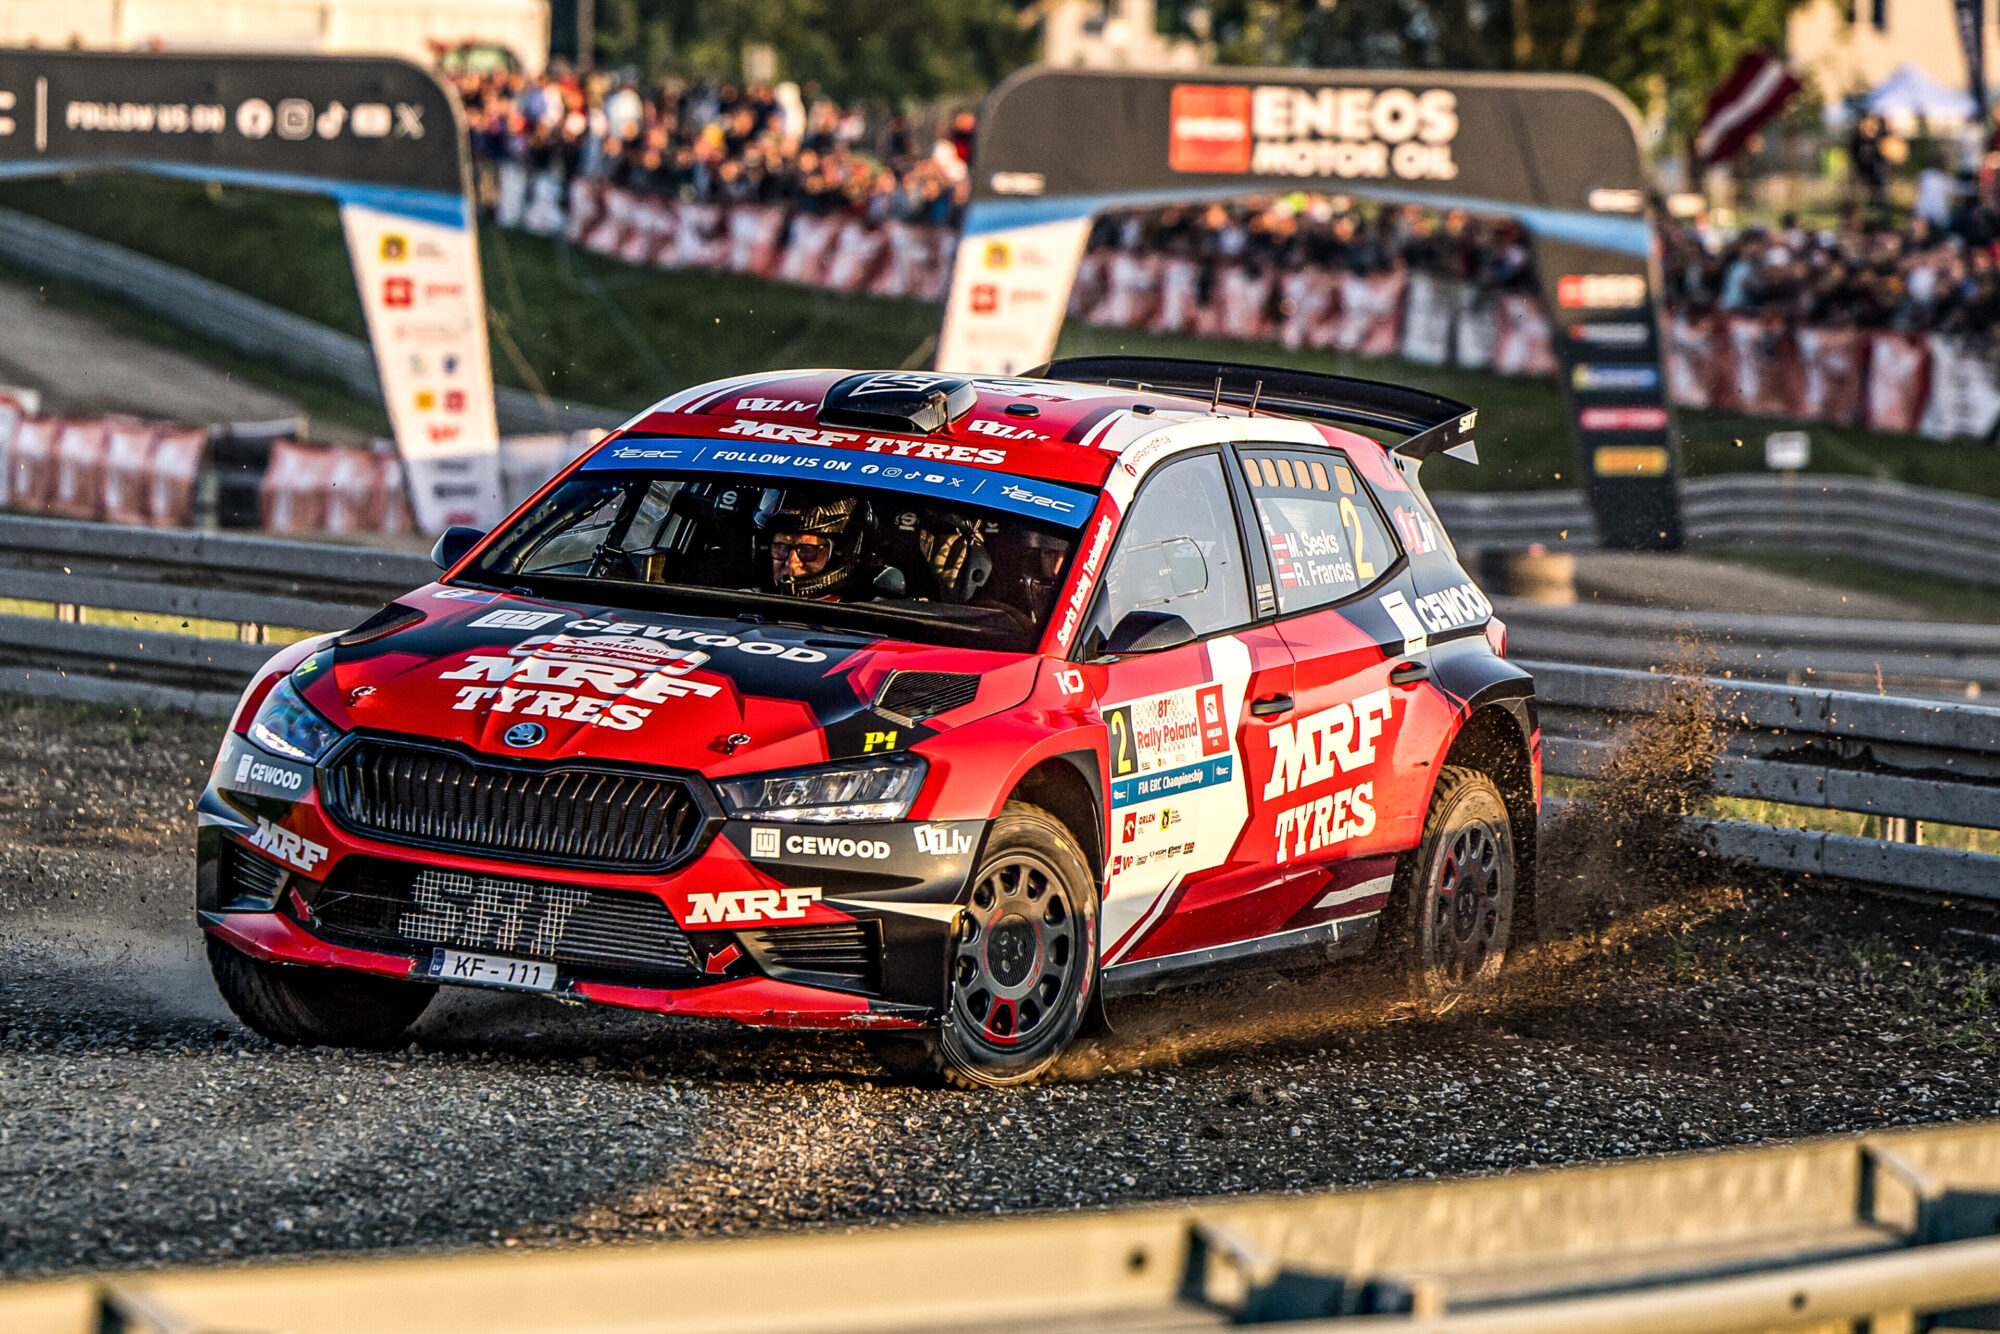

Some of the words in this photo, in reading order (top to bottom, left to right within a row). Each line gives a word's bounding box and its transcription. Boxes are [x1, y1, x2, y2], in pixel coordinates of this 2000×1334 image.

[66, 100, 155, 132] FOLLOW
[157, 103, 190, 134] US
[191, 104, 227, 133] ON
[1252, 86, 1458, 145] ENEOS
[1252, 141, 1389, 177] MOTOR
[1392, 142, 1458, 180] OIL
[713, 450, 791, 465] FOLLOW
[792, 456, 820, 468] US
[823, 459, 852, 471] ON
[718, 419, 860, 447] MRF
[864, 437, 1007, 465] TYRES
[1285, 532, 1303, 558] M.
[1300, 529, 1340, 556] Sesks
[1339, 496, 1377, 579] 2
[1293, 561, 1310, 587] R.
[1307, 557, 1355, 586] Francis
[1070, 572, 1092, 611] Racing
[564, 618, 828, 663] CEWOOD
[591, 641, 644, 651] ORLEN
[646, 647, 670, 656] OIL
[611, 651, 659, 664] Poland
[439, 655, 724, 704] MRF
[452, 686, 653, 731] TYRES
[864, 731, 898, 752] P1
[1111, 710, 1132, 775] 2
[1136, 727, 1161, 752] Rally
[1163, 717, 1198, 743] Poland
[1264, 687, 1393, 801] MRF
[250, 763, 302, 790] CEWOOD
[1150, 776, 1162, 792] ERC
[1163, 768, 1204, 788] Championship
[1275, 782, 1377, 865] TYRES
[248, 815, 329, 872] MRF
[785, 836, 891, 860] CEWOOD
[685, 887, 822, 924] MRF
